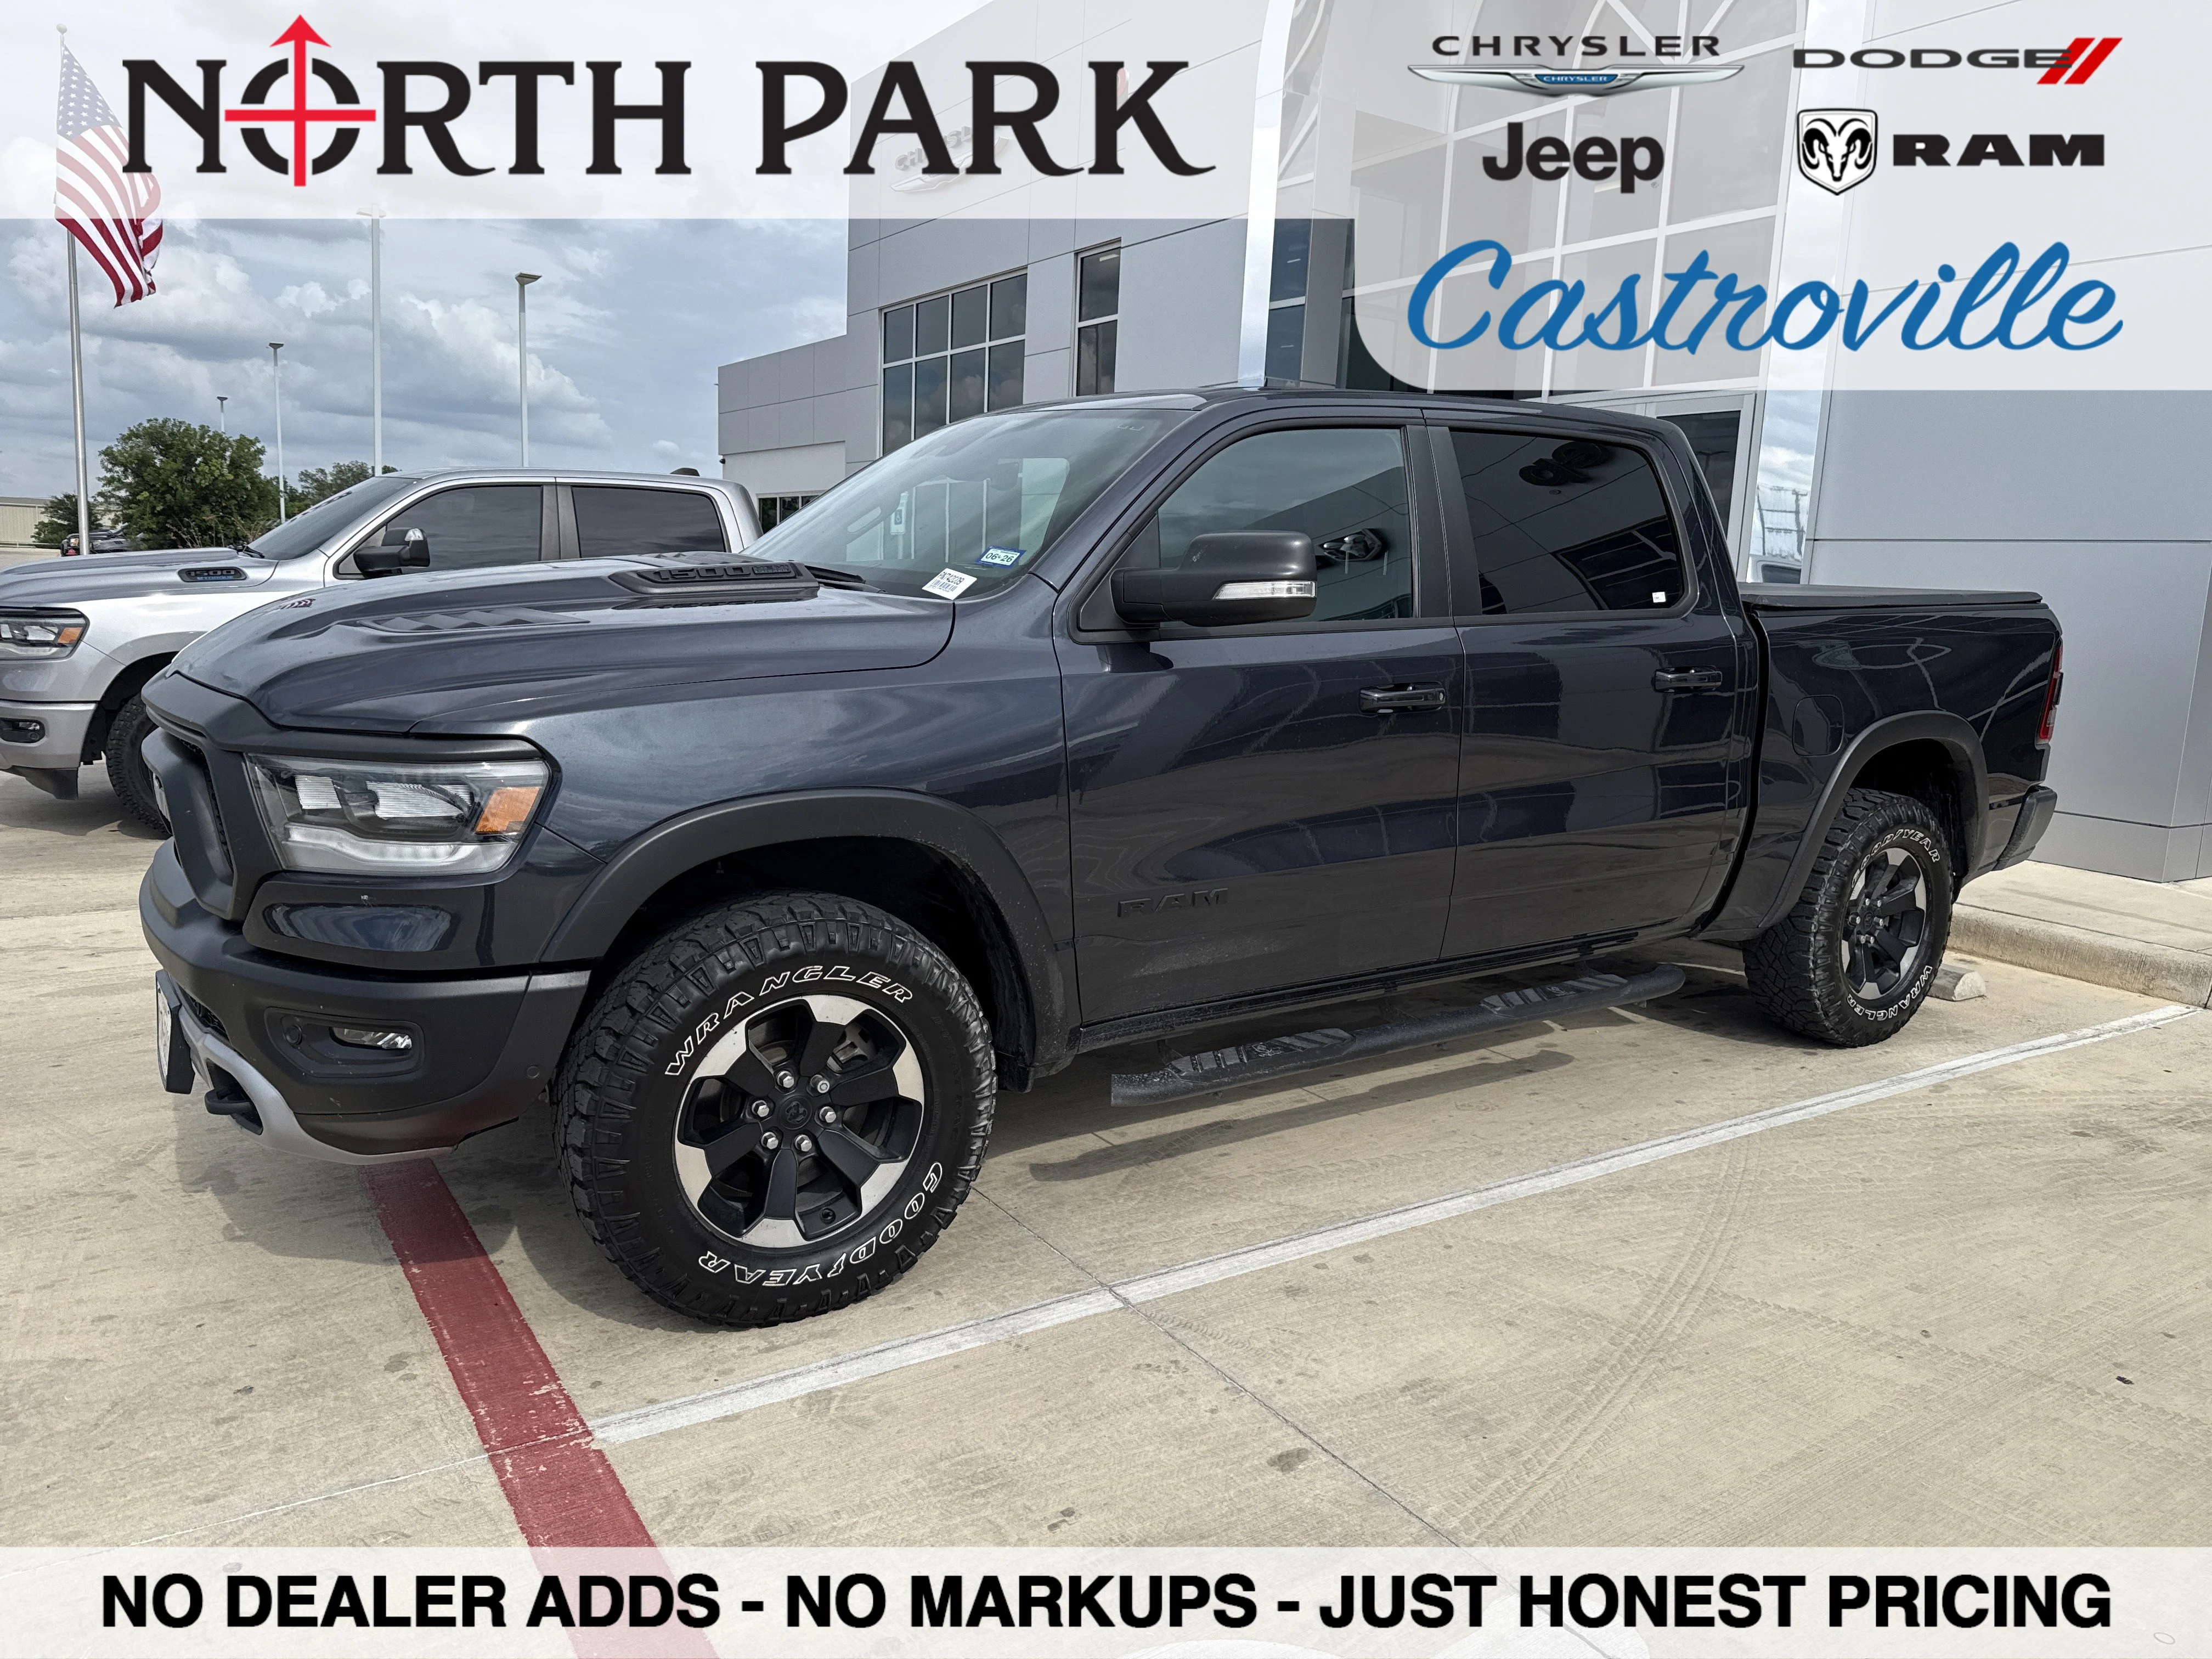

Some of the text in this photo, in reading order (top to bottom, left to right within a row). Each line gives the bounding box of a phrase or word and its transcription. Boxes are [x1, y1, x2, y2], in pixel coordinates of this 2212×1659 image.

[654, 566, 751, 580] 1500
[985, 552, 998, 560] 06
[1851, 829, 1940, 888] GOODYEAR
[1117, 887, 1229, 917] RAM
[664, 964, 914, 1077] WRANGLER
[1846, 965, 1933, 1021] WRANGLER
[698, 1161, 944, 1287] GOODYEAR
